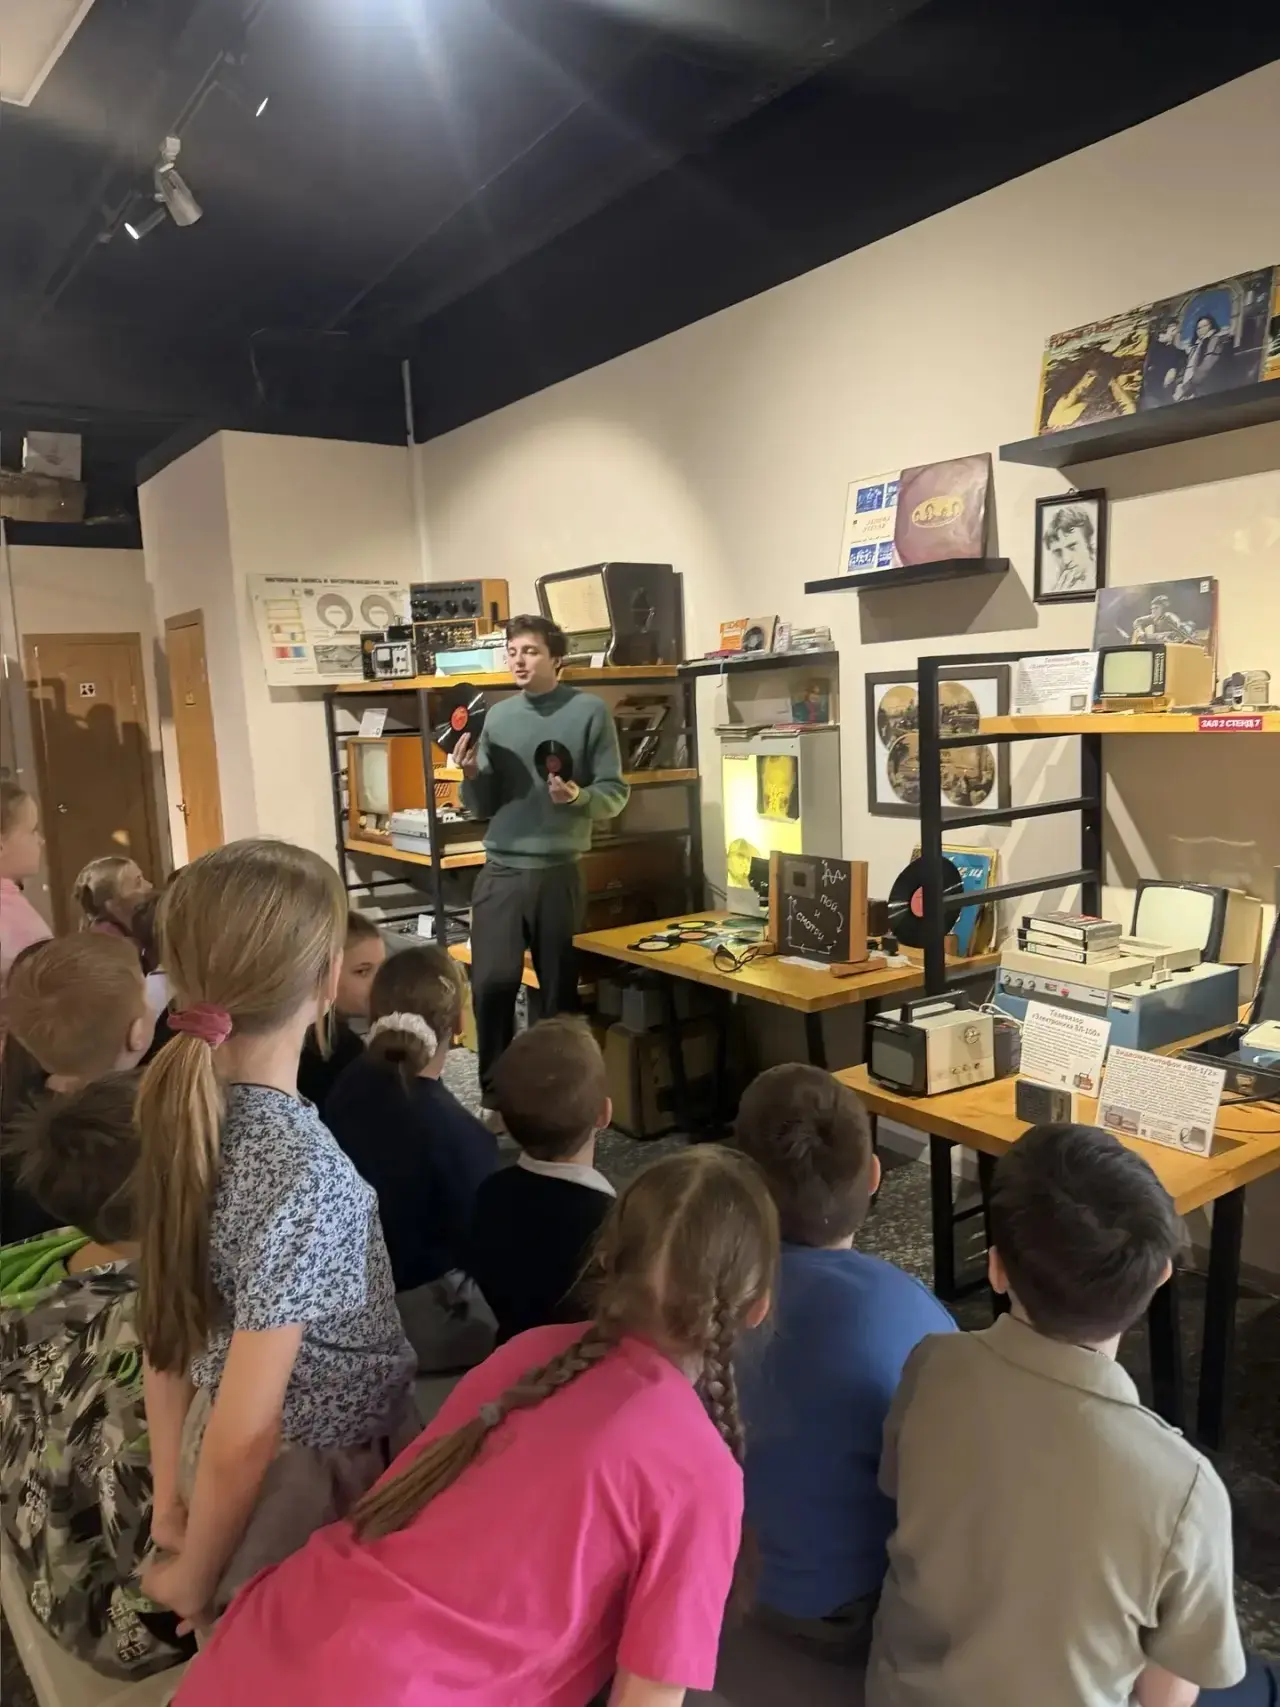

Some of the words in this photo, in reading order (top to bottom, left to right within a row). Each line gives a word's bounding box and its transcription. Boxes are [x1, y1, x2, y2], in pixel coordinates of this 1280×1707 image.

[1225, 719, 1254, 728] СТЕНД
[1254, 718, 1261, 728] 7
[1049, 1008, 1085, 1024] Телевизор
